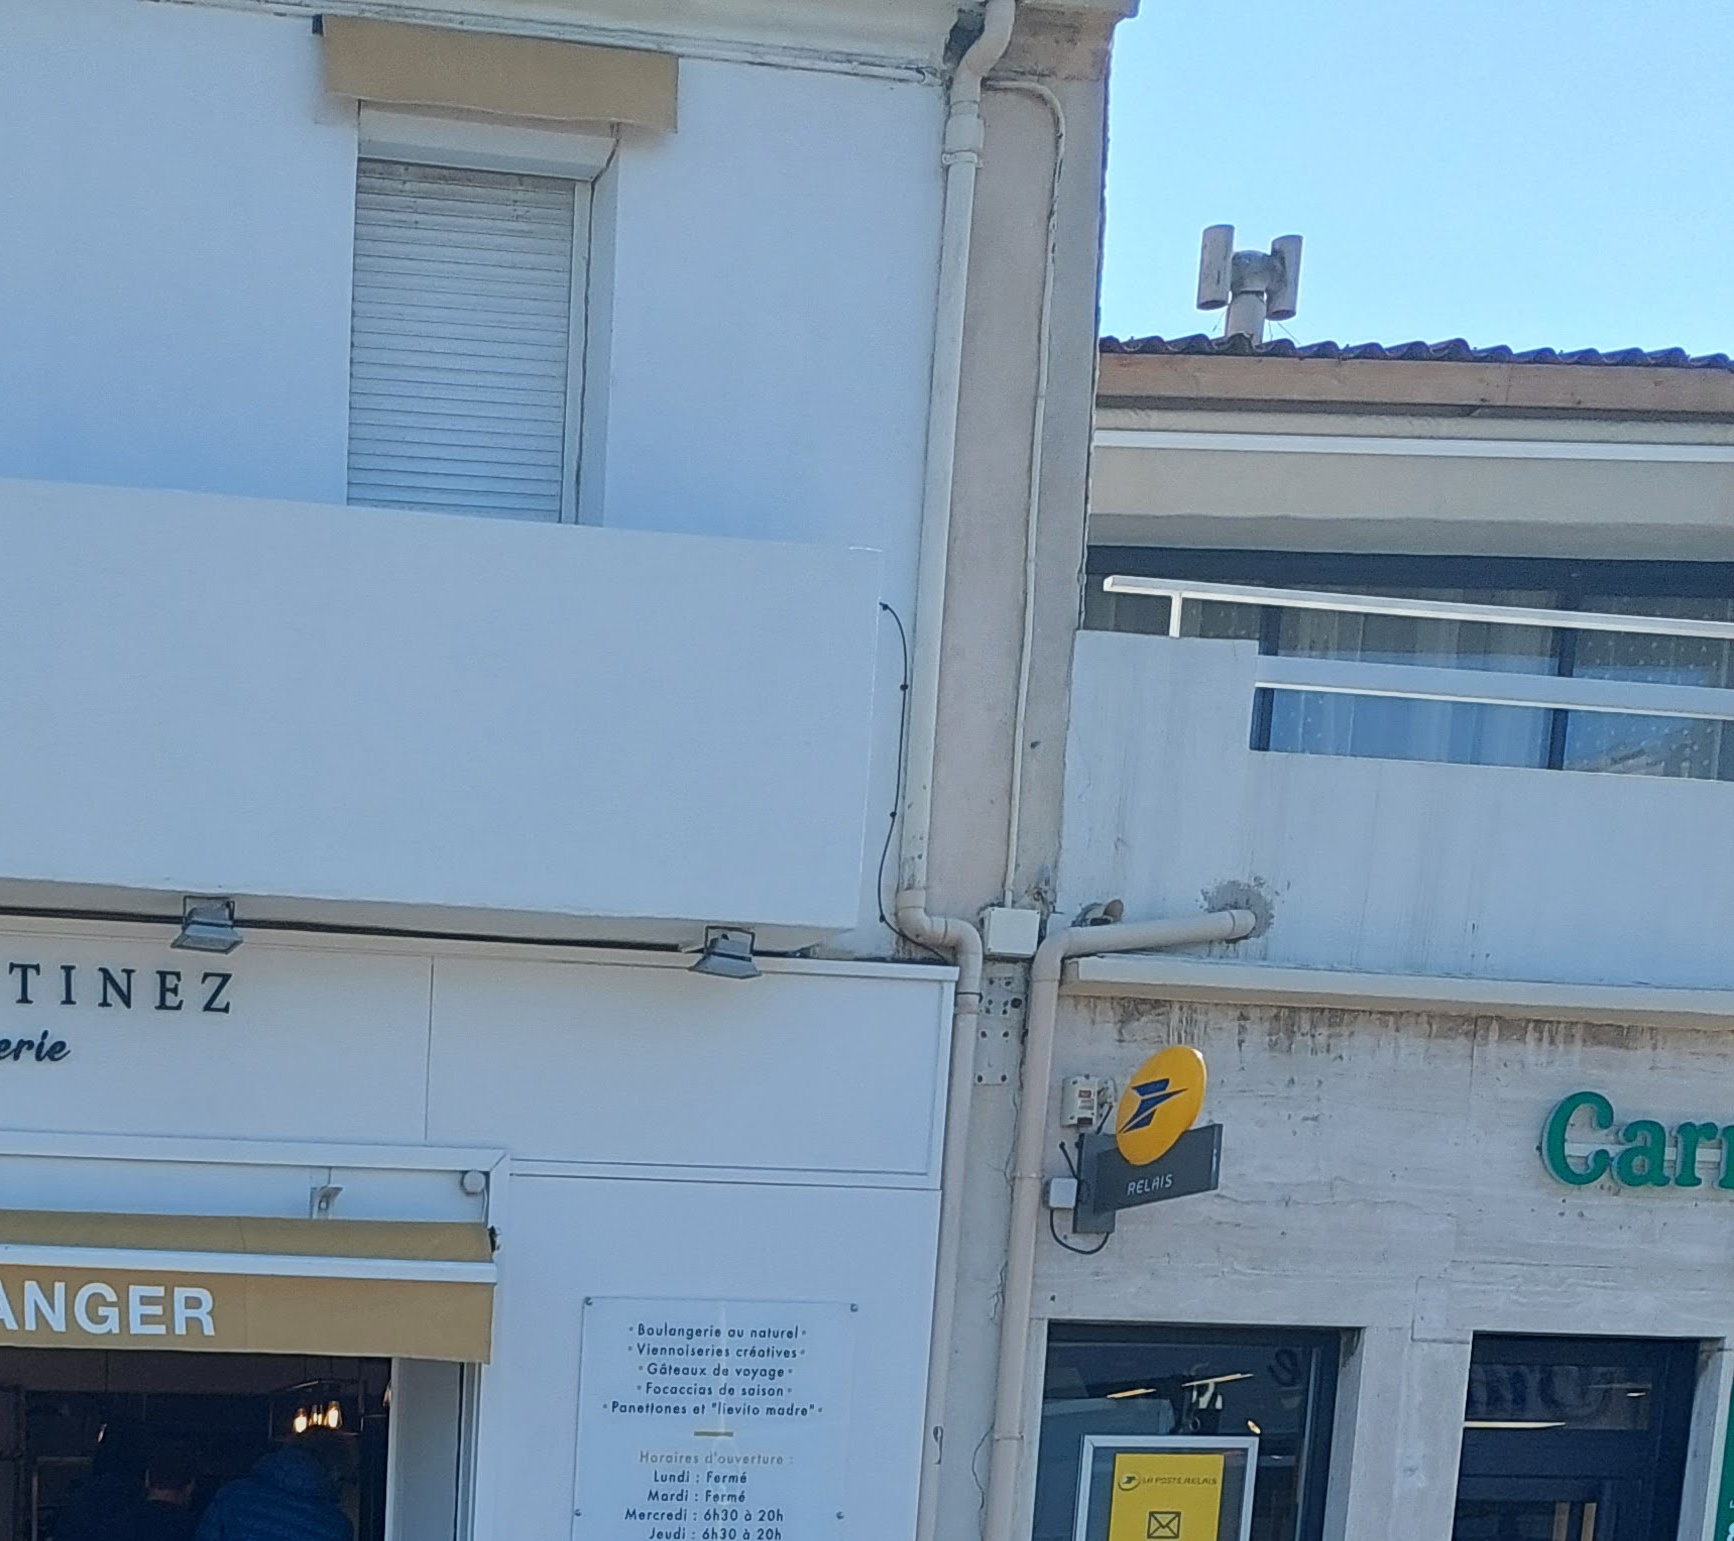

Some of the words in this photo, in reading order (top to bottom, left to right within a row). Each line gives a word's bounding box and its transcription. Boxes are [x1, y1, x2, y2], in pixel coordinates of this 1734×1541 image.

[1127, 1174, 1173, 1196] RELAIS
[638, 1322, 721, 1340] Boulangerie
[727, 1328, 744, 1339] au
[750, 1325, 799, 1339] naturel
[637, 1343, 730, 1358] Viennoiseries
[736, 1344, 797, 1359] créatives
[646, 1362, 707, 1377] Gâteaux
[713, 1363, 729, 1377] de
[735, 1367, 785, 1380] voyage
[646, 1382, 713, 1396] Focaccias
[718, 1383, 735, 1396] de
[741, 1385, 784, 1397] saison
[611, 1401, 687, 1415] Panettones
[693, 1403, 706, 1415] et
[639, 1451, 699, 1464] Horaires
[705, 1452, 784, 1465] d'ouverture
[654, 1471, 690, 1484] Lundi
[706, 1471, 747, 1484] Fermé
[647, 1489, 689, 1502] Mardi
[705, 1490, 746, 1503] Fermé
[624, 1508, 687, 1521] Mercredi
[703, 1509, 739, 1522] 6h30
[744, 1509, 752, 1522] à
[757, 1509, 784, 1522] 20h
[648, 1528, 686, 1540] Jeudi
[702, 1528, 737, 1541] 6h30
[742, 1528, 750, 1541] à
[756, 1528, 782, 1541] 20h
